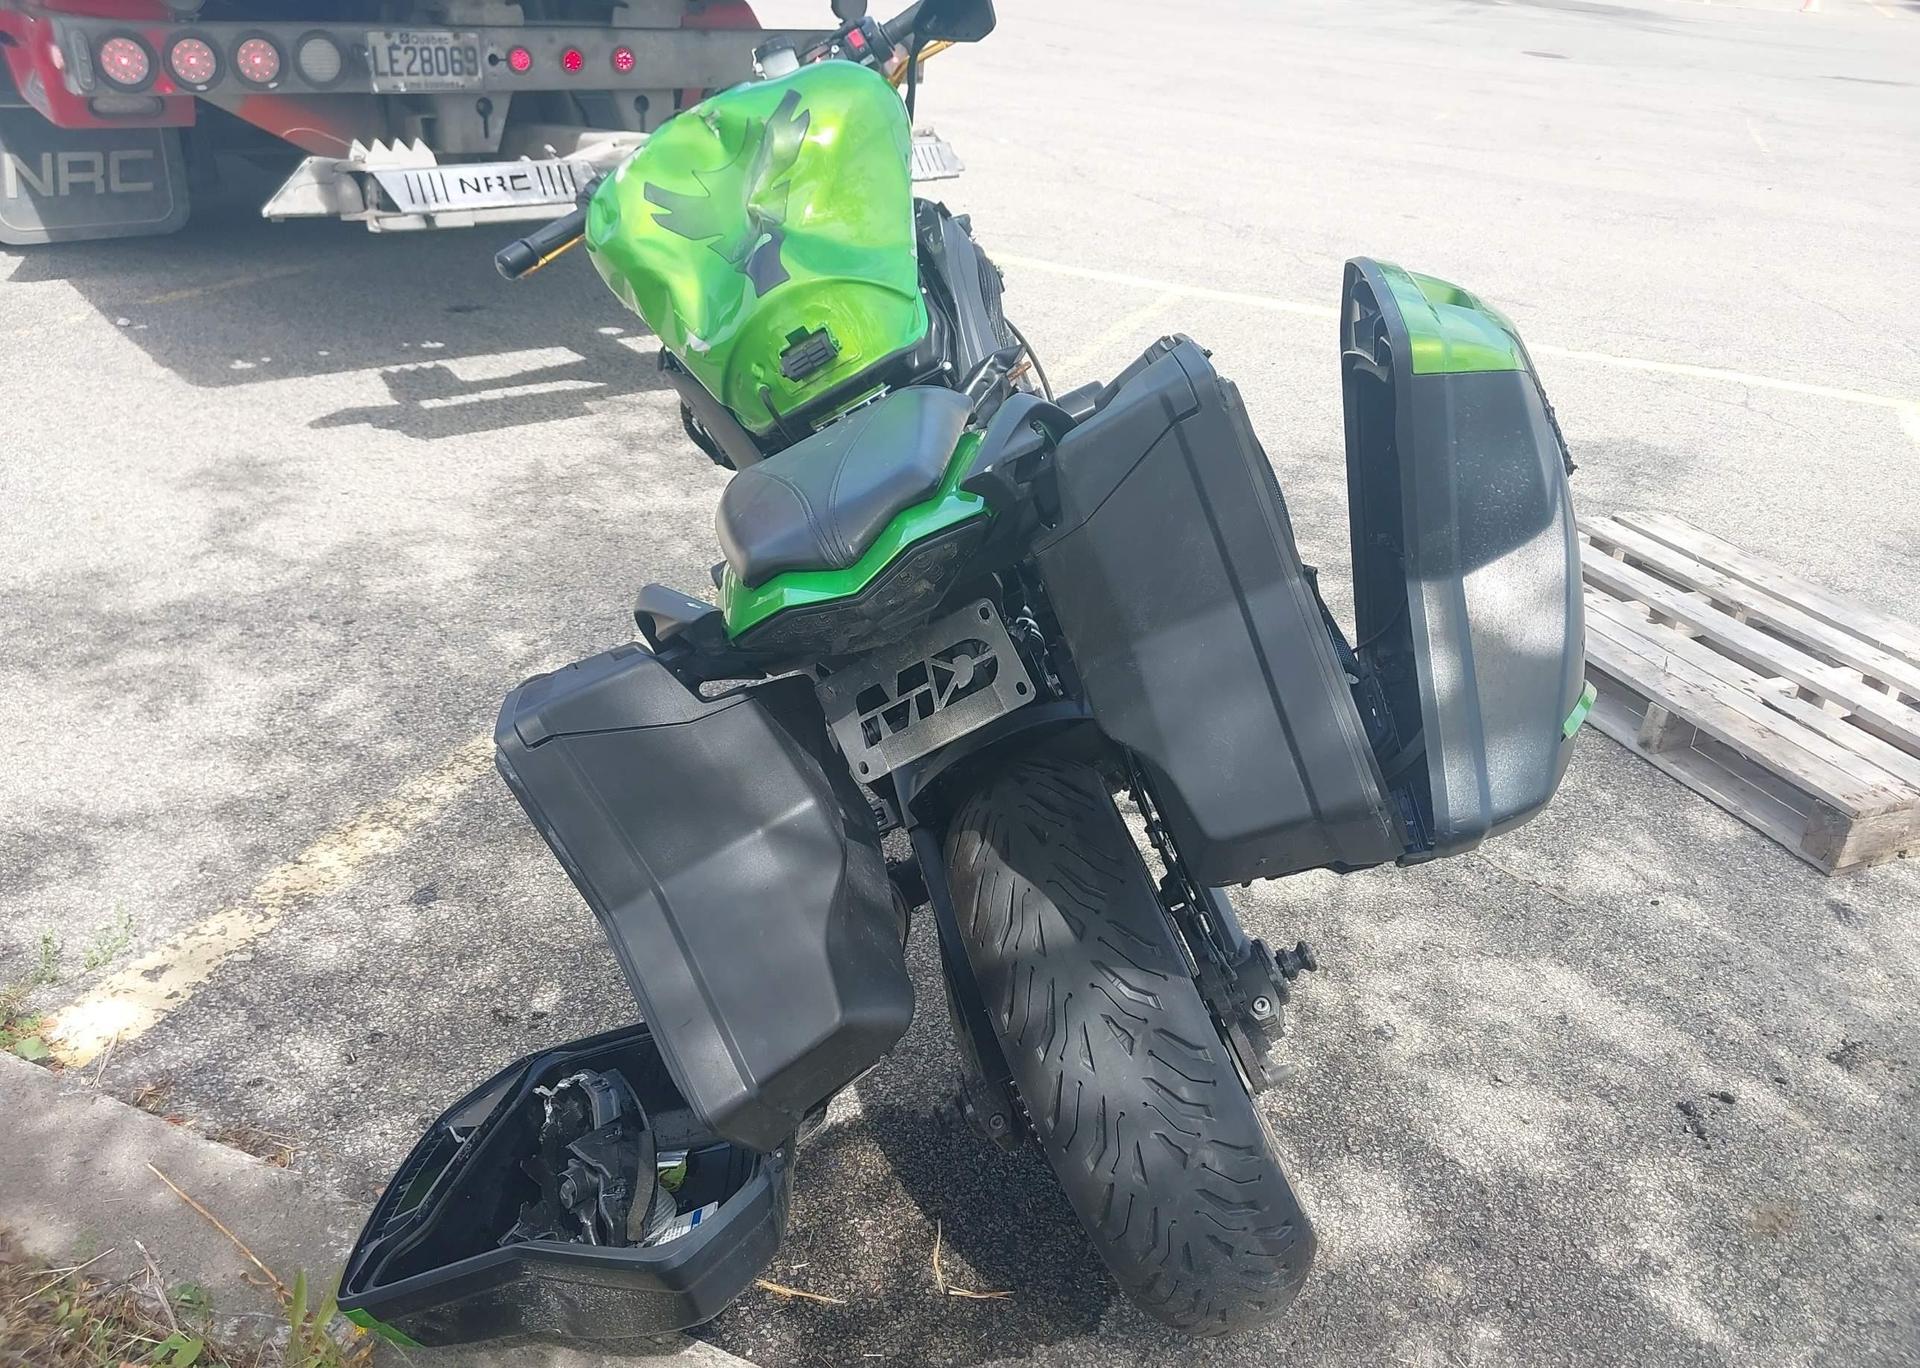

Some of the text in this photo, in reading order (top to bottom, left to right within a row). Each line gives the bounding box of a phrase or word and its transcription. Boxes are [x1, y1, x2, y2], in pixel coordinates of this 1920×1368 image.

[371, 45, 479, 76] LE28069
[3, 149, 154, 199] NRC
[458, 173, 531, 194] NRC
